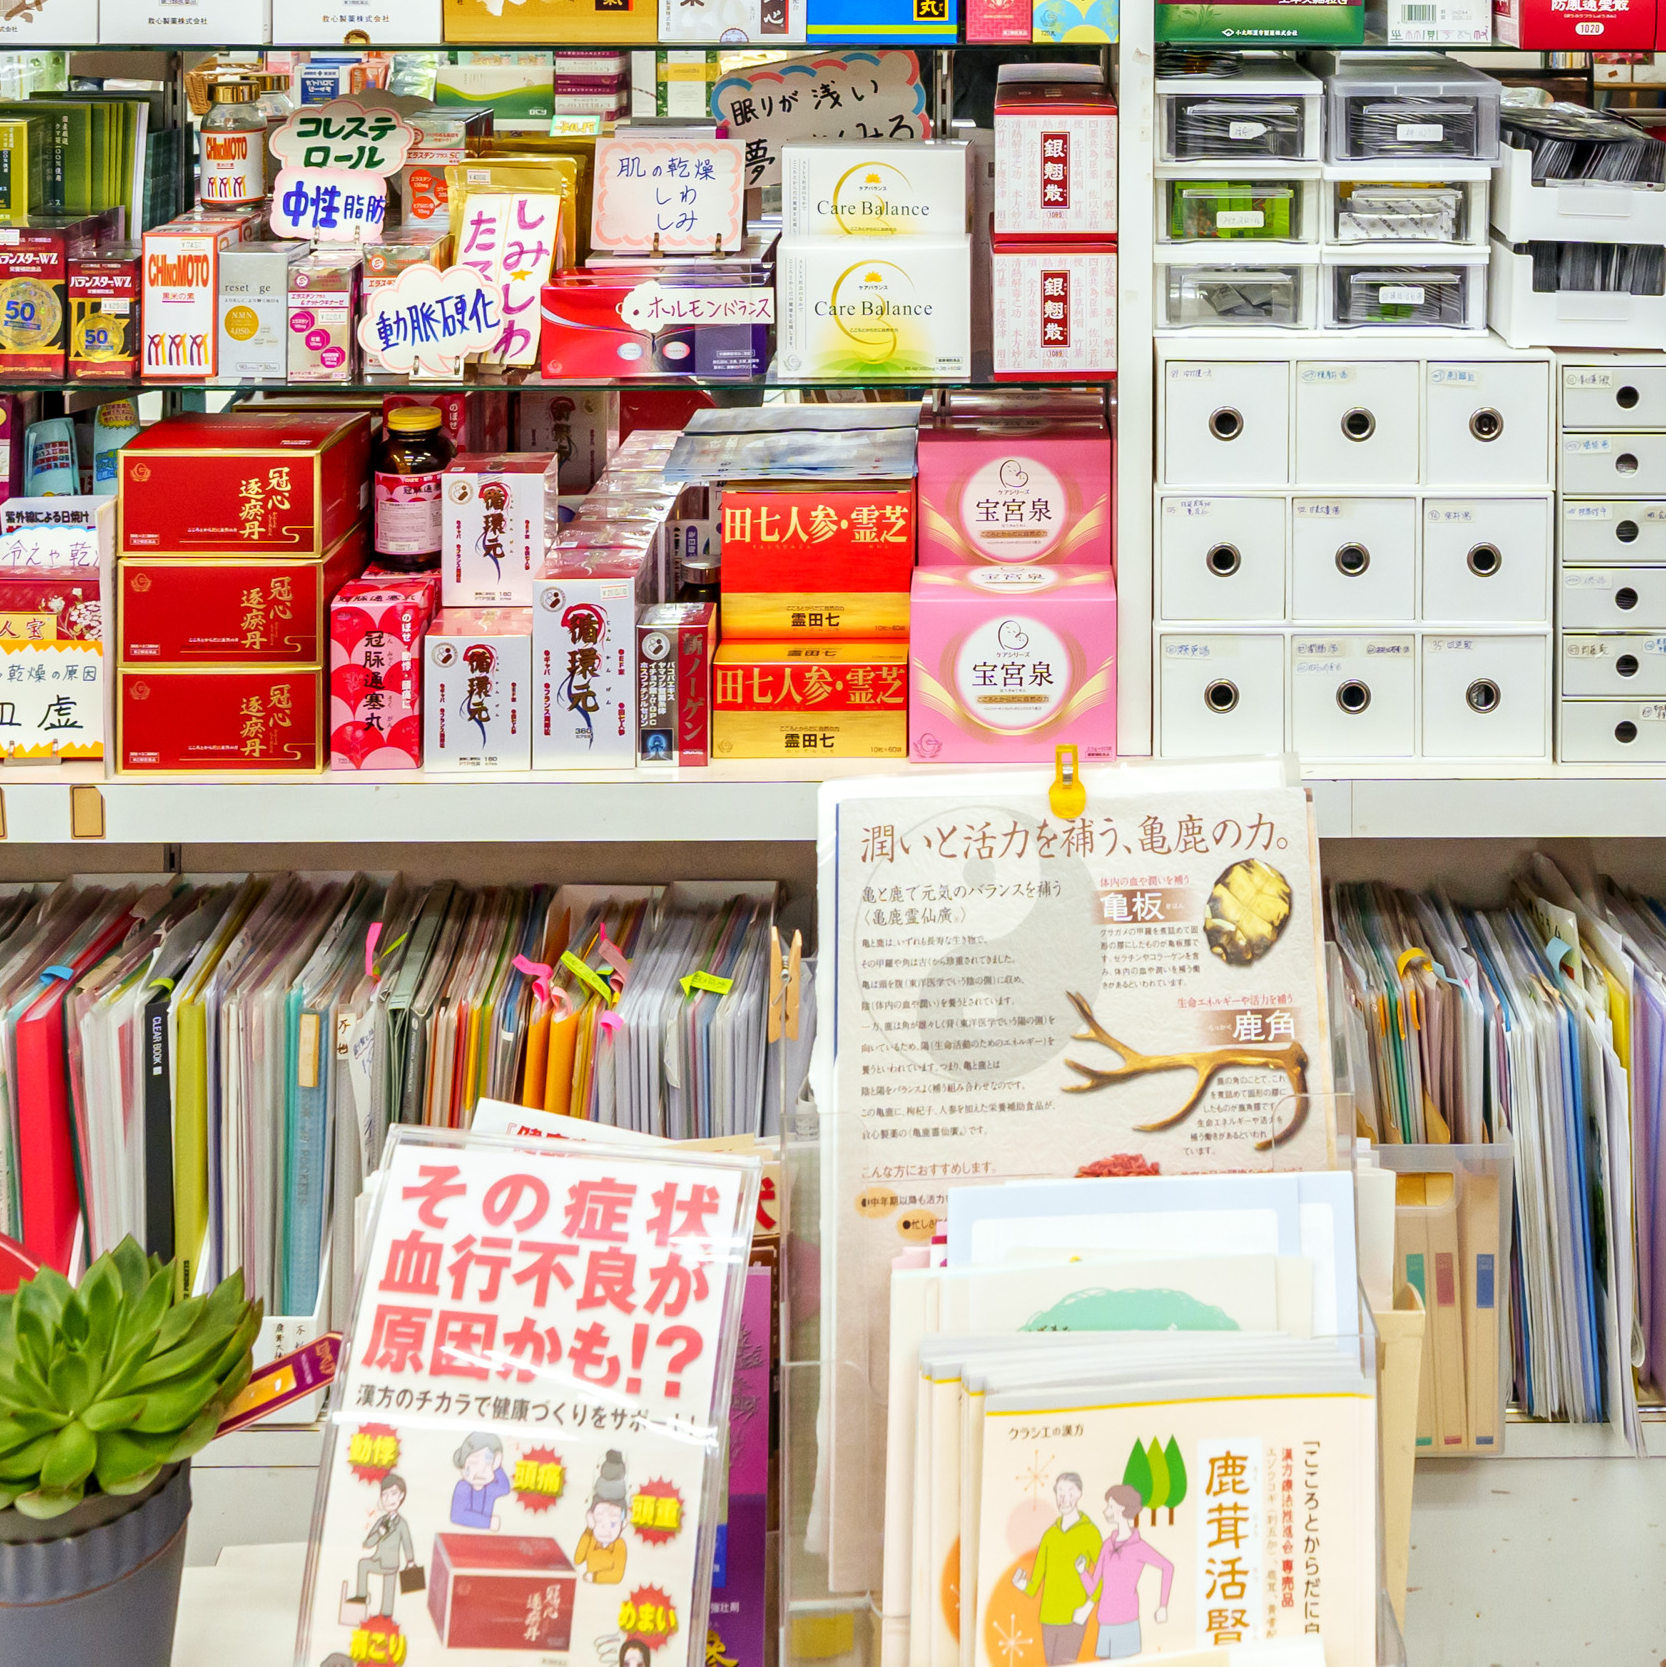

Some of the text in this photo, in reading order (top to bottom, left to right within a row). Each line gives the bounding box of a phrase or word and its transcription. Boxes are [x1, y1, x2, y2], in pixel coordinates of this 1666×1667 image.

[147, 17, 208, 26] 救心製薬株式会社
[296, 117, 398, 141] コレステ
[303, 145, 385, 169] ロール
[617, 155, 716, 182] 肌の乾燥
[646, 295, 774, 322] ホルモンバランス
[813, 299, 933, 317] Care Balance
[374, 291, 502, 353] 動脈硬化
[971, 660, 1055, 689] 宝宮泉
[783, 732, 835, 750] 霊田七
[860, 811, 1291, 864] 潤いと活力を補う、亀鹿の力。
[861, 880, 1064, 904] 亀と鹿で元気のバランスを補う
[1100, 874, 1190, 888] 体内の血や潤いを補う
[1099, 892, 1165, 922] 亀板
[1177, 994, 1294, 1008] 生命エネルギーや活力を補う
[1233, 1010, 1296, 1041] 鹿角
[401, 1163, 720, 1246] その症状
[378, 1229, 713, 1316] 血行不良が
[1007, 1424, 1084, 1441] クラシエの漢方
[513, 1458, 562, 1494] 頭痛
[619, 1600, 678, 1632] めまい
